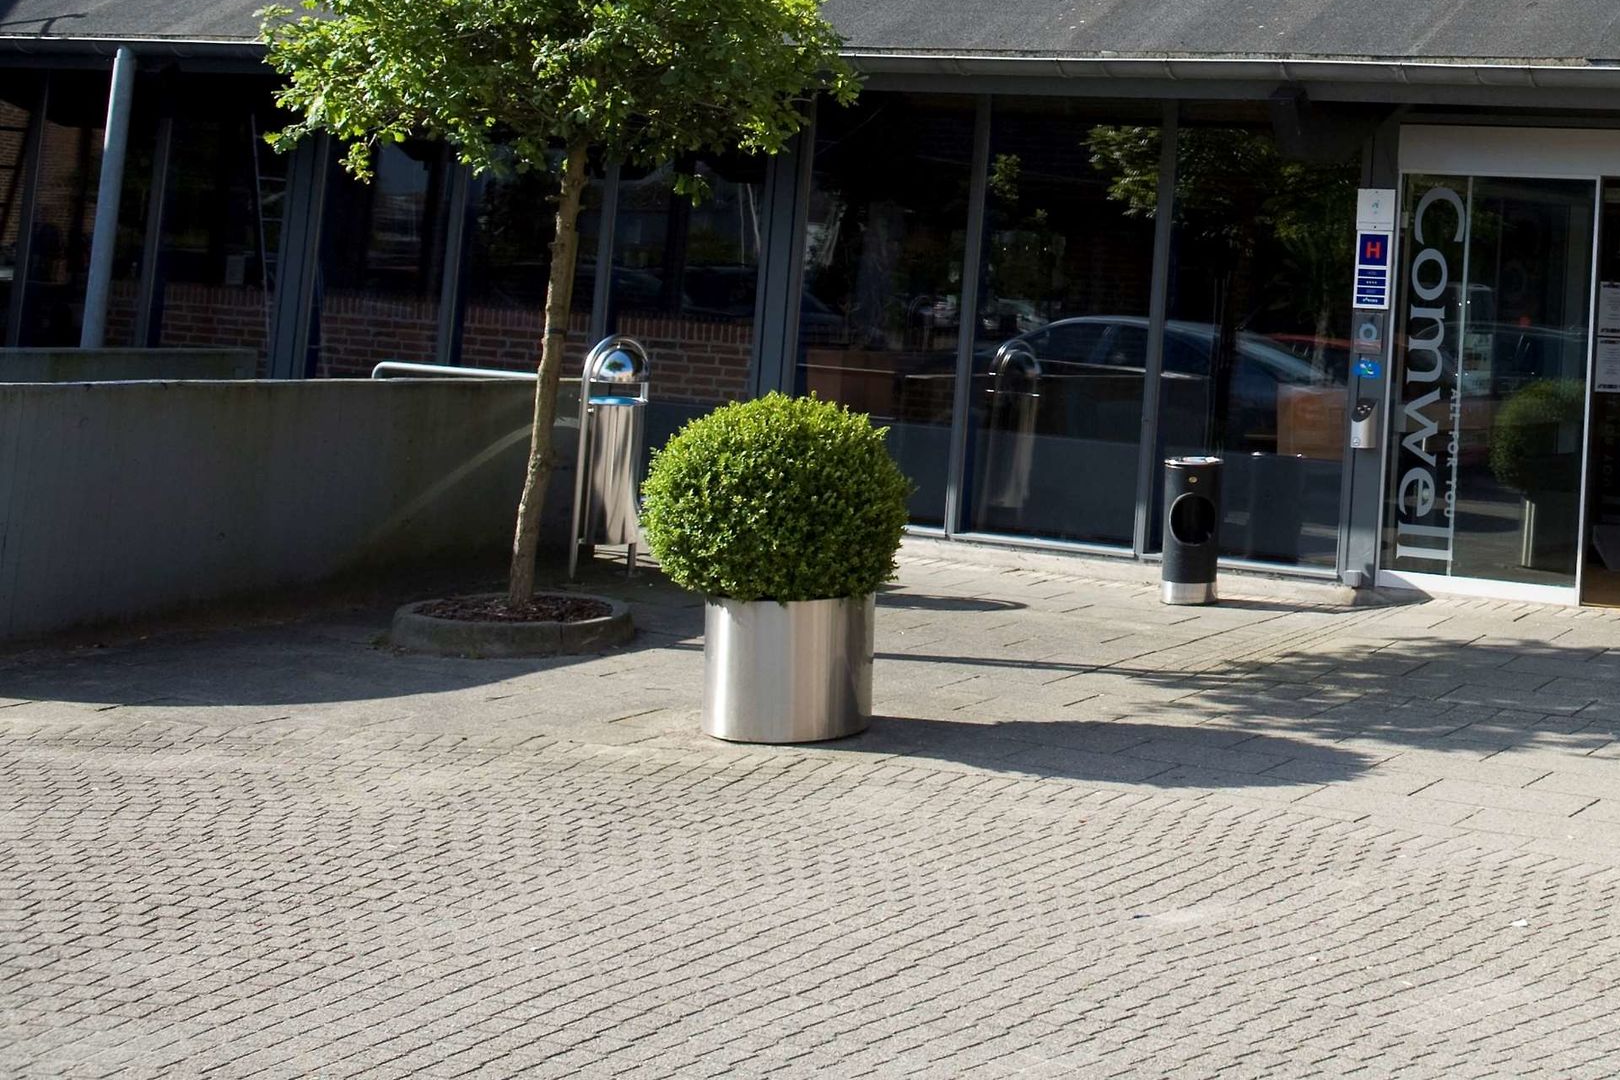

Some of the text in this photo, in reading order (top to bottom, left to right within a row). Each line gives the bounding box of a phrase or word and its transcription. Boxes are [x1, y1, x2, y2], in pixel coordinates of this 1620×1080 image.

[1364, 241, 1382, 260] H
[1394, 186, 1466, 560] Comwell
[1444, 388, 1461, 518] ALL FOR YOU
